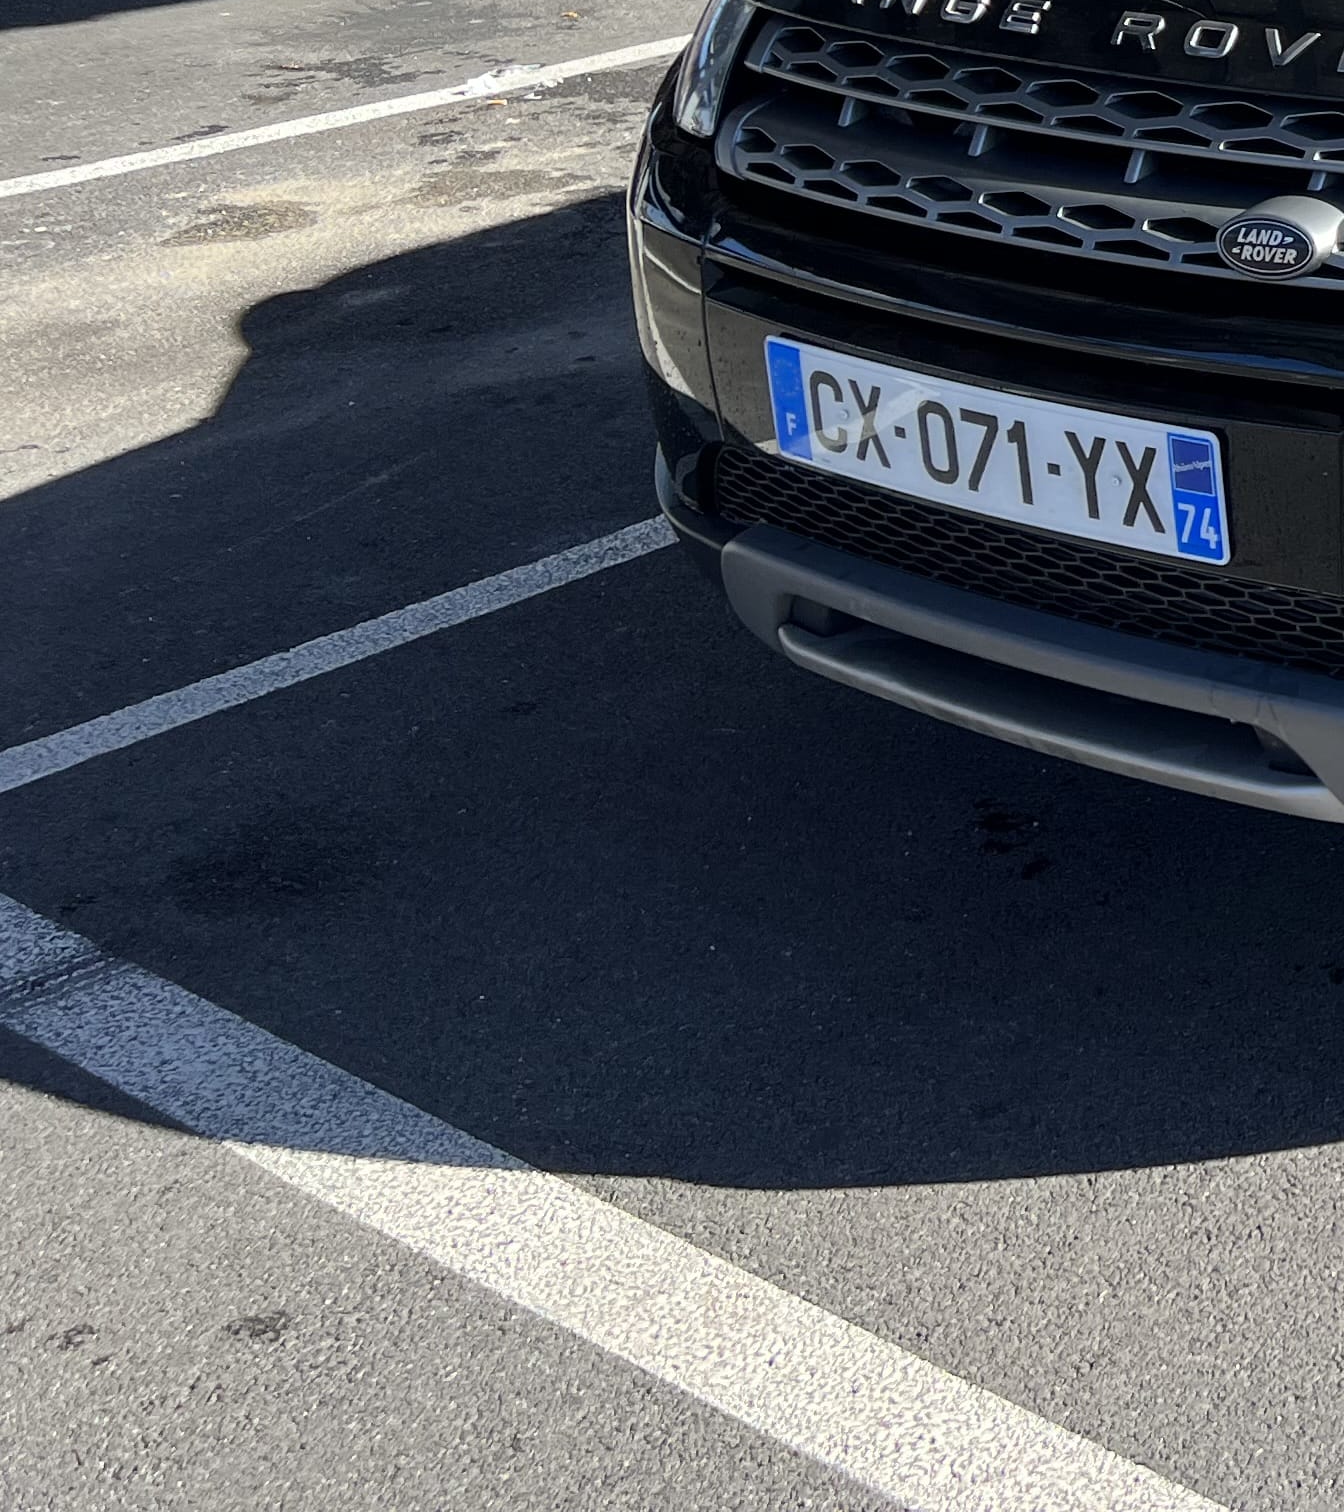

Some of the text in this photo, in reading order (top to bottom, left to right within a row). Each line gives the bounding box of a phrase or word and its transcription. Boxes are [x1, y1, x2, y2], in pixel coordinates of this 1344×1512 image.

[1237, 227, 1283, 246] LAND
[1240, 245, 1298, 265] ROVER
[808, 369, 1167, 535] CX-071-YX
[1177, 502, 1220, 550] 74
